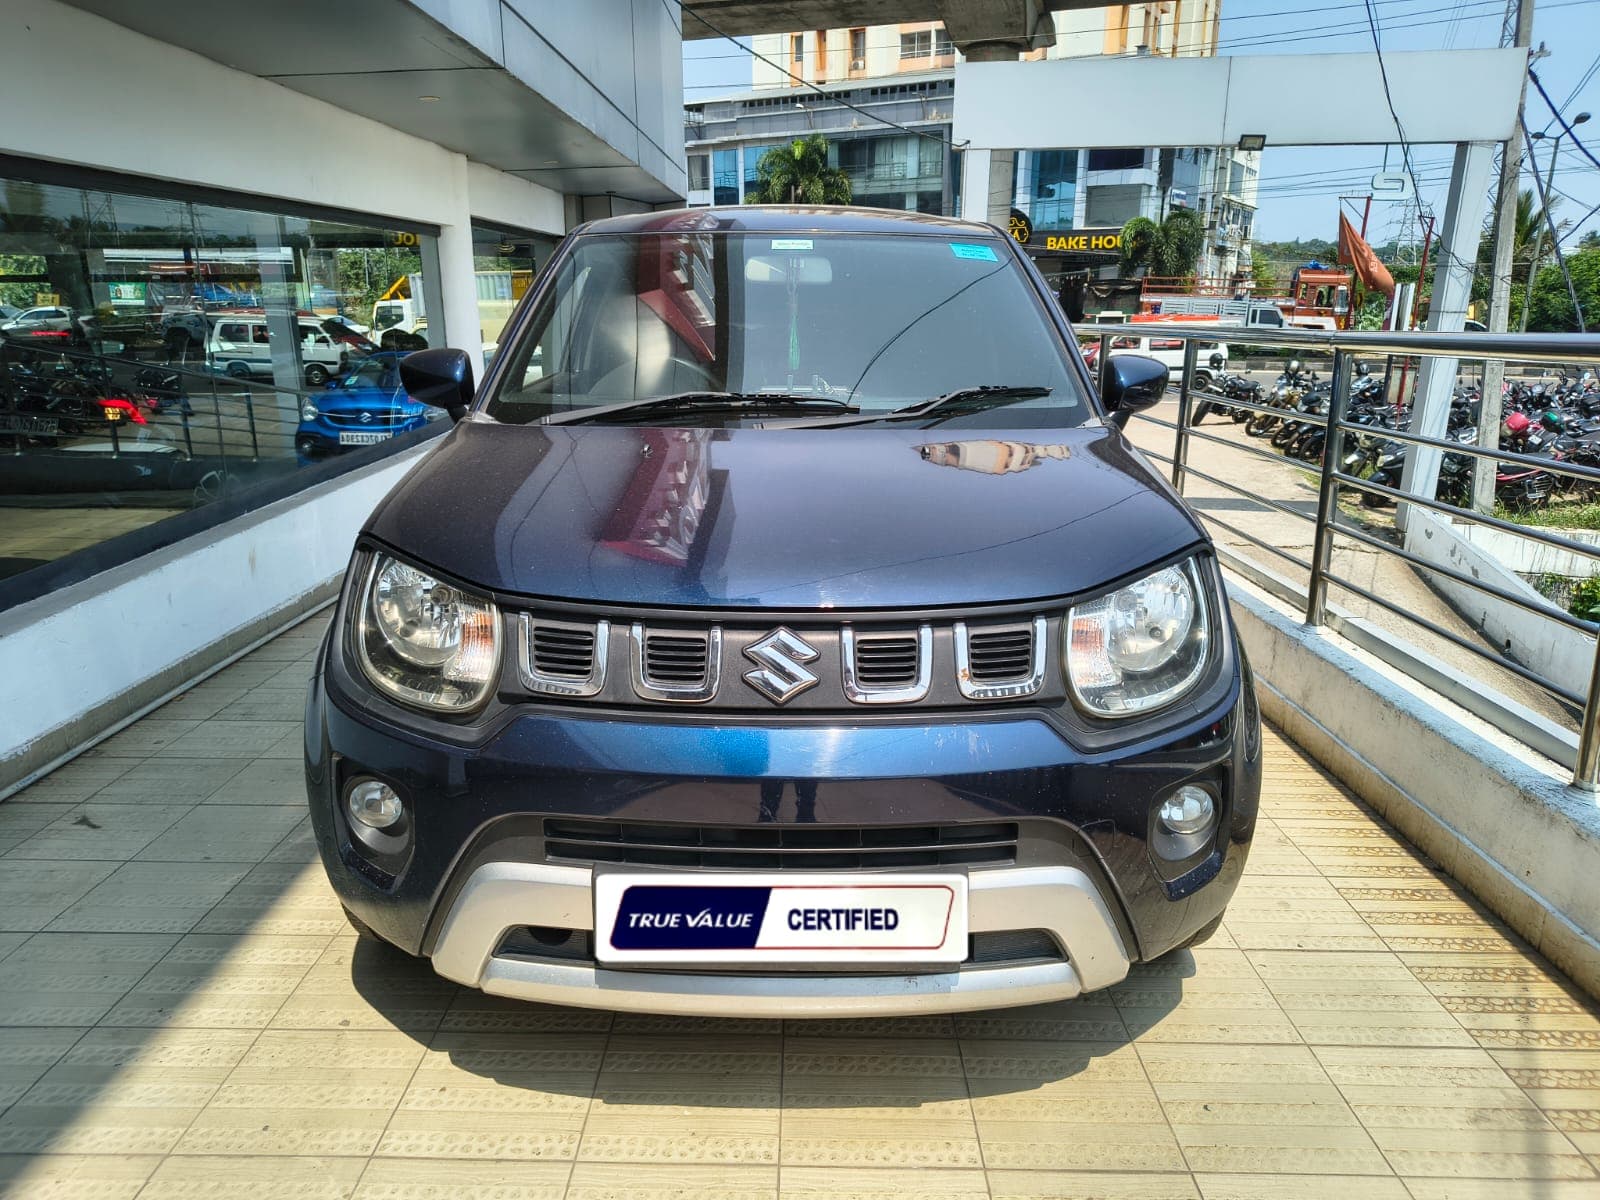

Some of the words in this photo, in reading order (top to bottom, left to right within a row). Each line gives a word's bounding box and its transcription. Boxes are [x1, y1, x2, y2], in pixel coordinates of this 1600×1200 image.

[1047, 236, 1088, 250] BAKE
[628, 912, 682, 928] TRUE
[685, 908, 754, 928] VALUE
[787, 907, 900, 931] CERTIFIED
